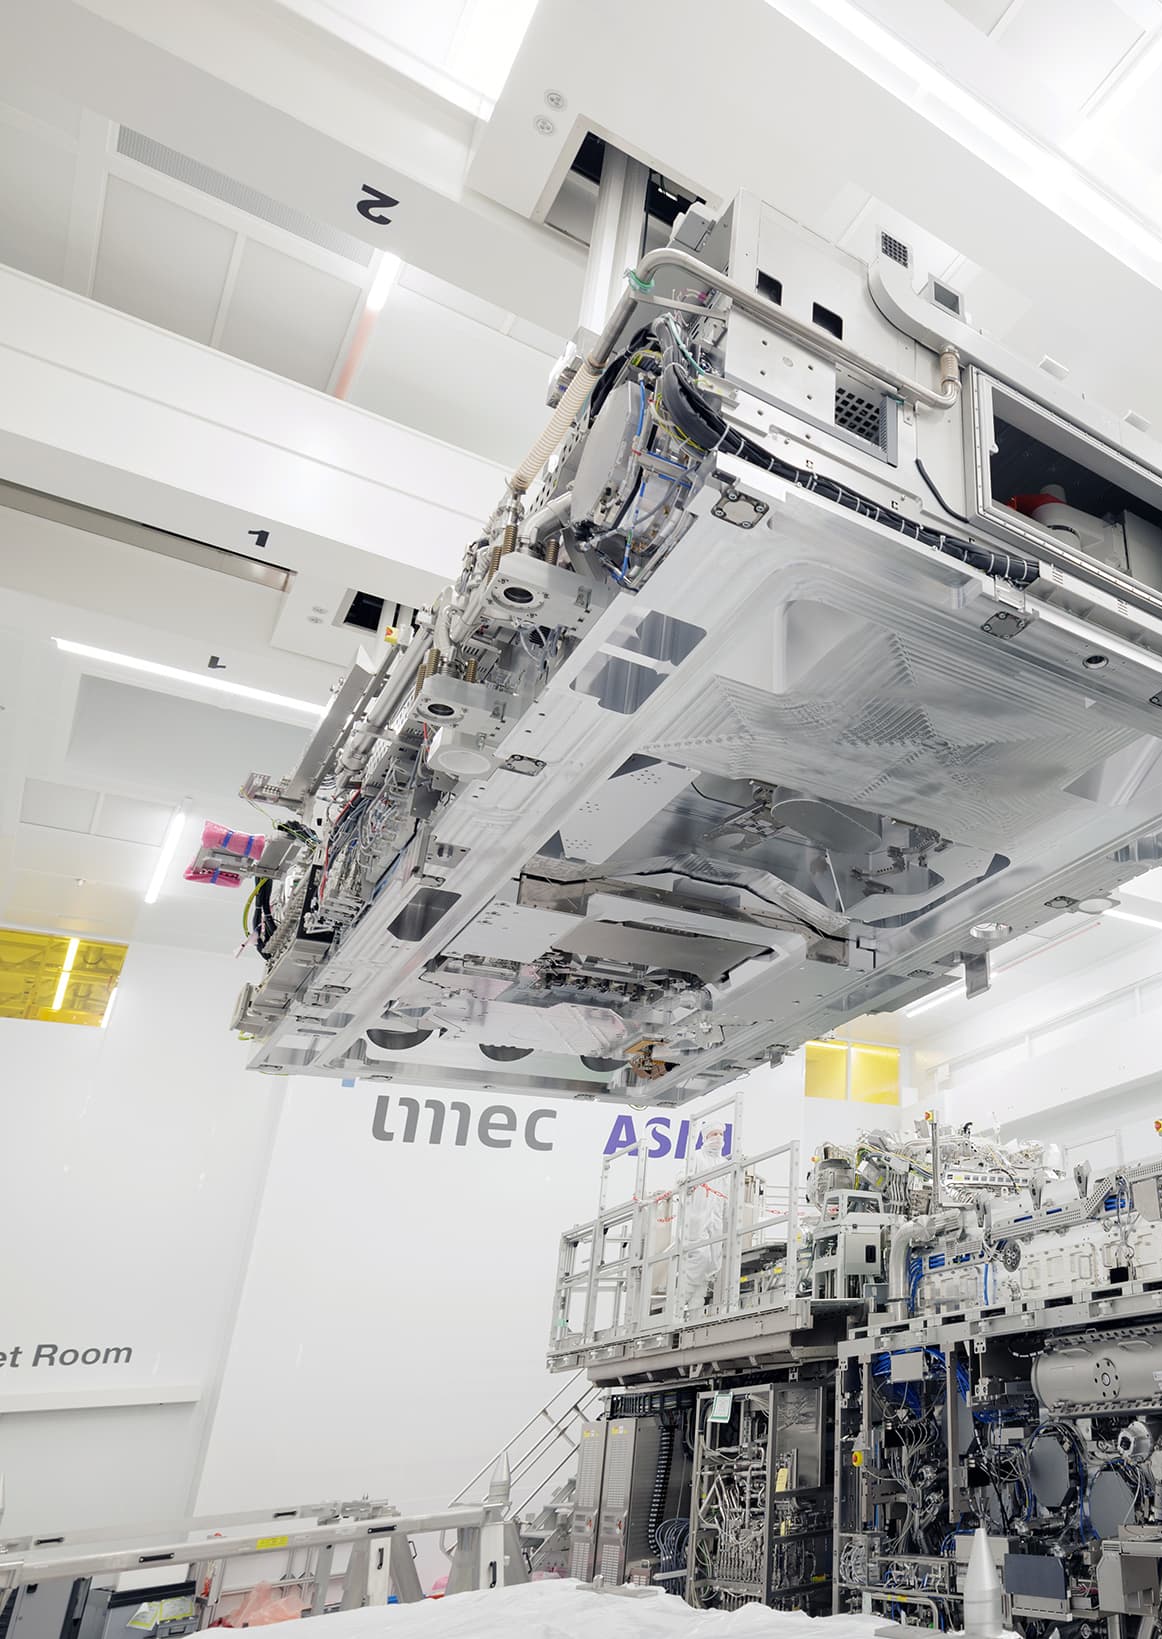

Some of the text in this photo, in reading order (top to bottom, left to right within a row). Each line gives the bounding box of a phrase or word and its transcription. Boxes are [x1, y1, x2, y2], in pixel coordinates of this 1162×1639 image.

[356, 183, 400, 225] 2
[247, 530, 270, 548] 1
[371, 1094, 558, 1152] imec
[31, 1343, 133, 1367] Room
